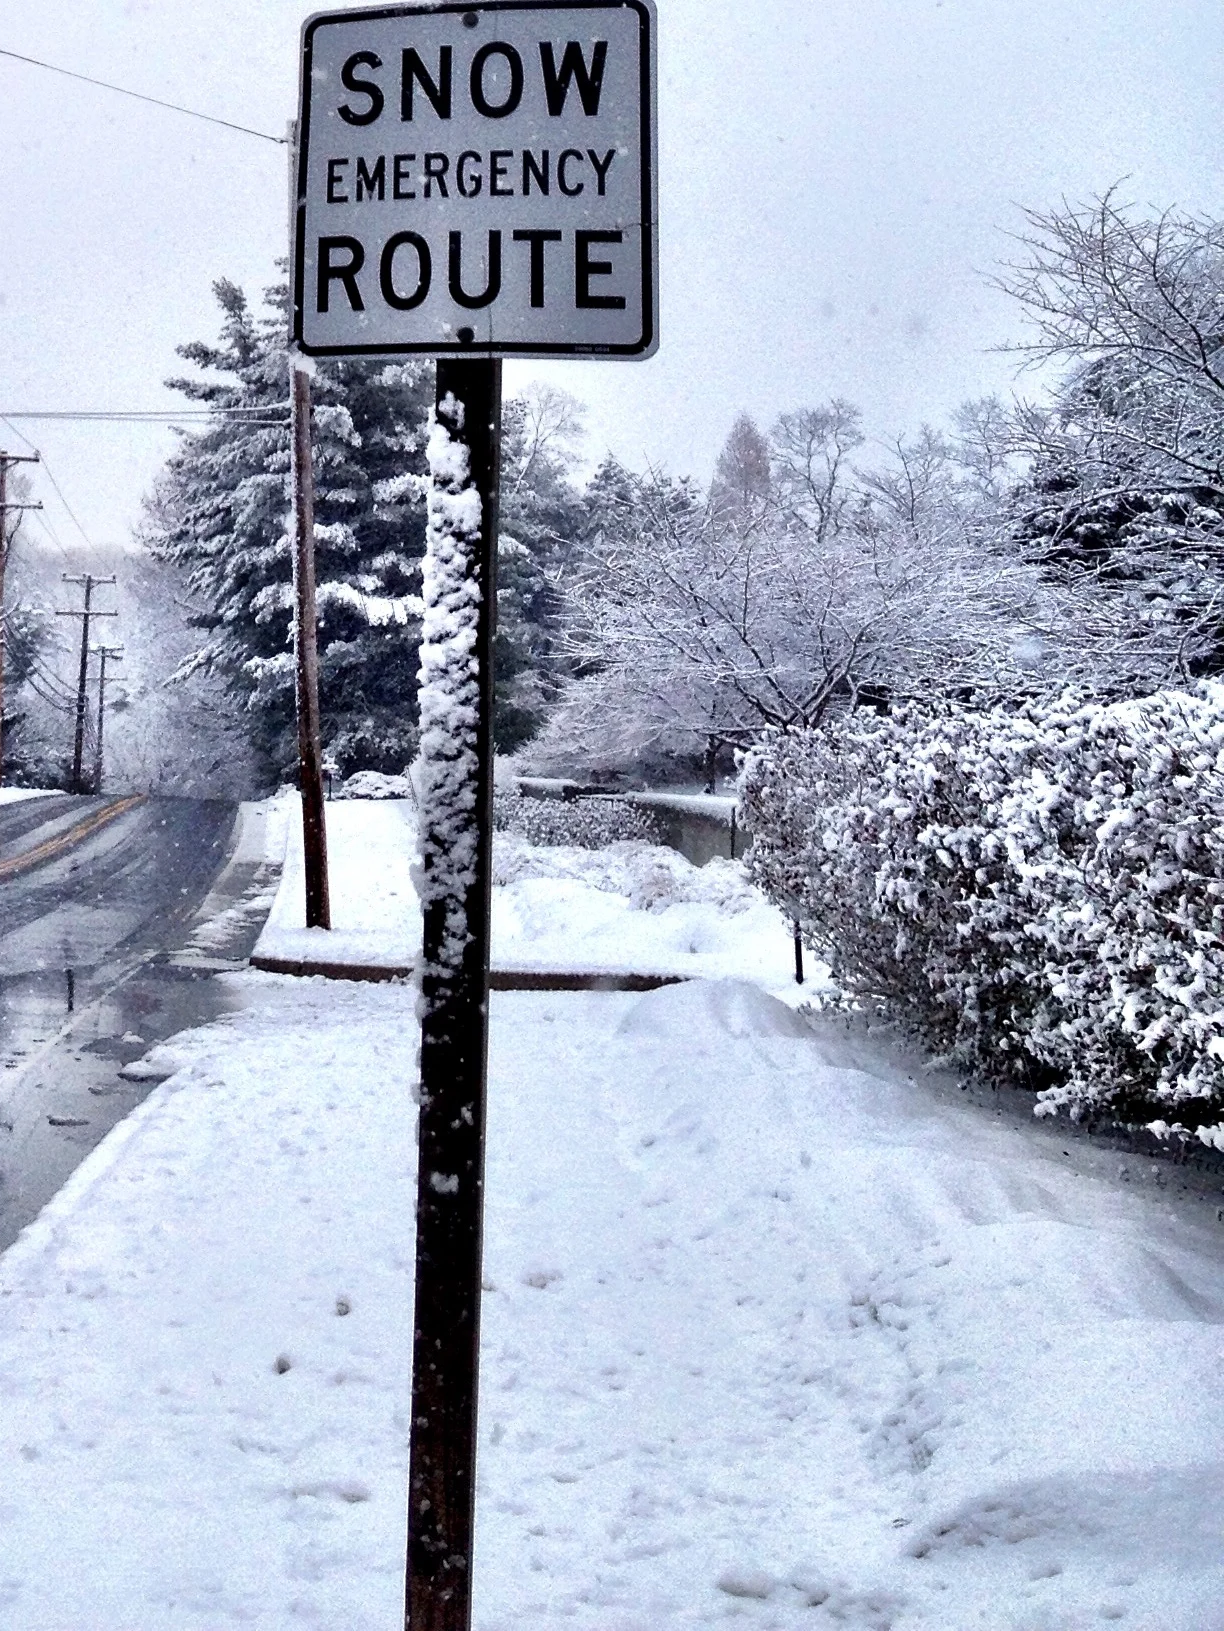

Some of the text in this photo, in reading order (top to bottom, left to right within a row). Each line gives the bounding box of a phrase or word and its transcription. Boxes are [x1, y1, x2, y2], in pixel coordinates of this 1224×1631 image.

[337, 39, 609, 127] SNOW
[326, 148, 617, 204] EMERGENCY
[316, 228, 626, 314] ROUTE
